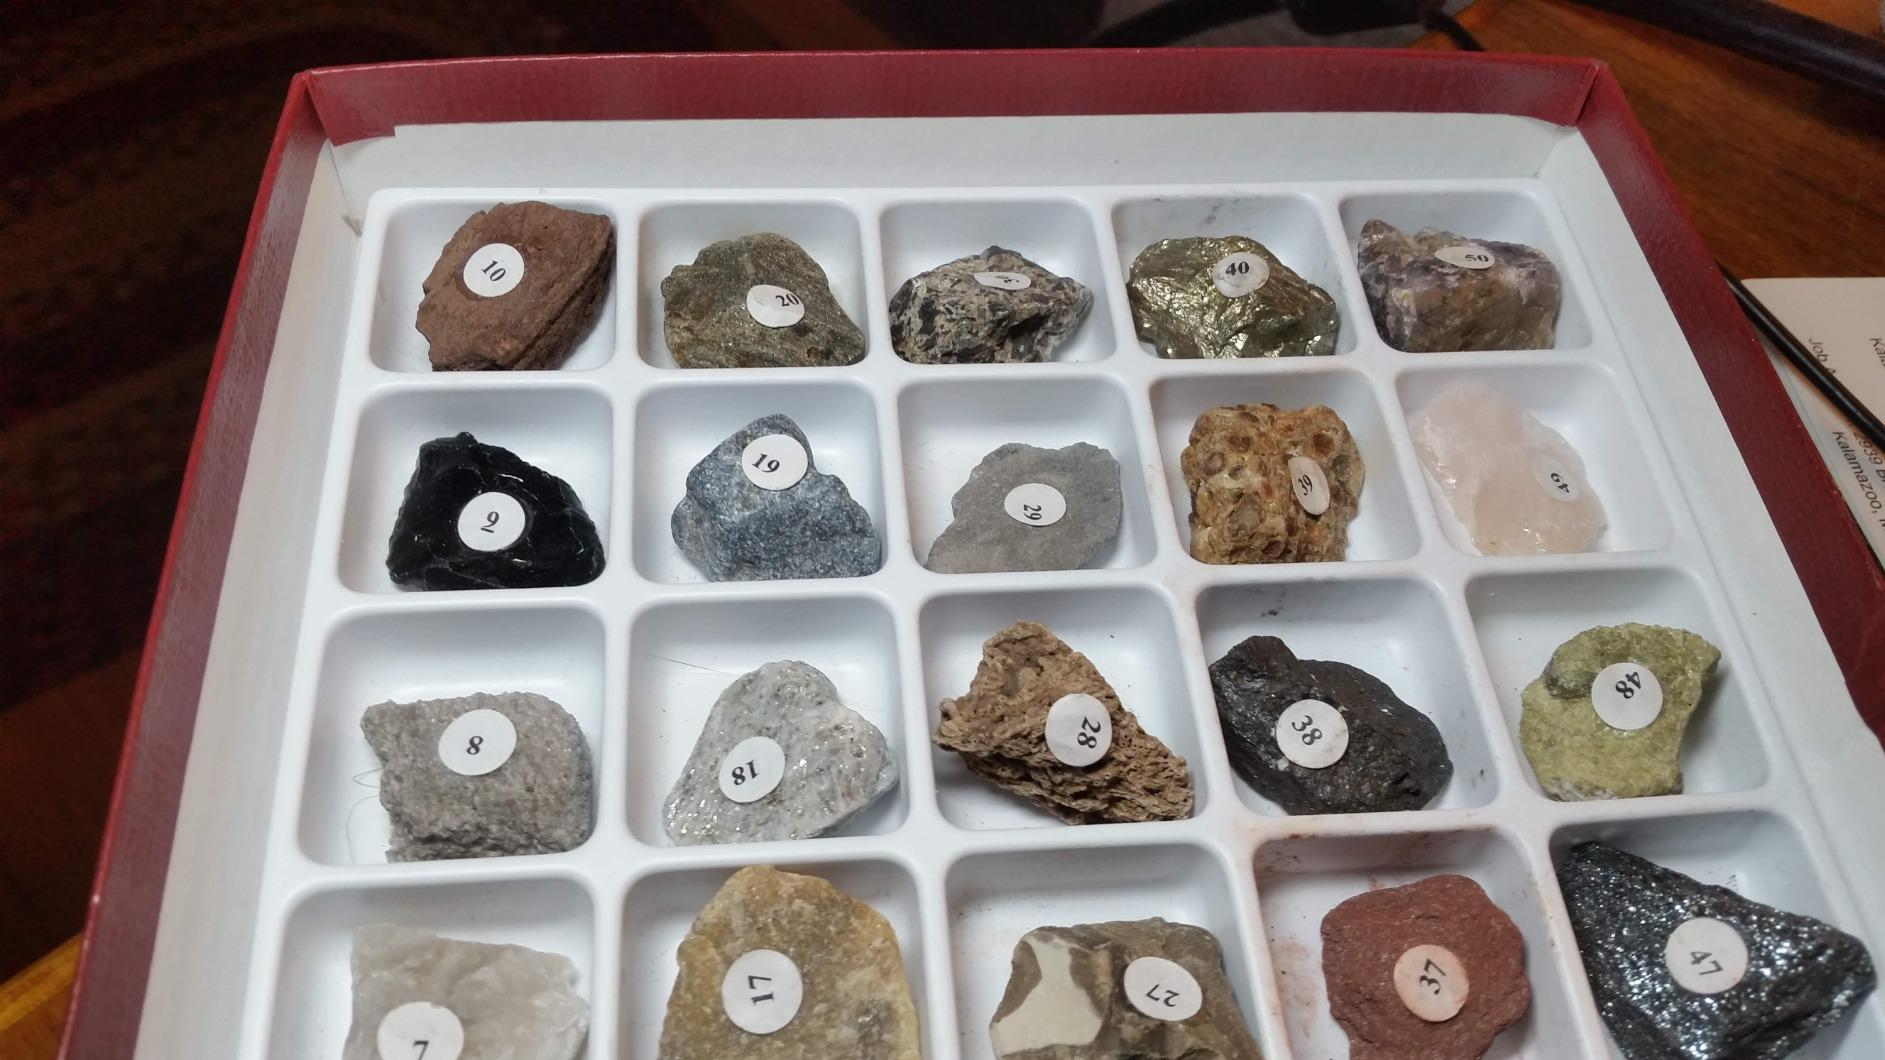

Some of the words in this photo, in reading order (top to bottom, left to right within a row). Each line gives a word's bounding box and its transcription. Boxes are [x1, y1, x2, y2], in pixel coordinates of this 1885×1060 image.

[1226, 261, 1249, 276] 40
[1465, 254, 1488, 262] 50
[481, 261, 506, 282] 10
[776, 293, 800, 307] 20
[1808, 338, 1829, 362] Job
[751, 453, 780, 473] 19
[1832, 432, 1882, 513] Kalamazoo,
[1298, 474, 1313, 495] 39
[1551, 472, 1569, 493] 49
[481, 512, 500, 533] 9
[1024, 504, 1041, 520] 29
[1615, 671, 1642, 698] 48
[1077, 717, 1100, 749] 28
[1292, 715, 1322, 746] 38
[467, 736, 483, 755] 8
[732, 760, 759, 785] 18
[1690, 950, 1723, 976] 47
[1420, 958, 1446, 994] 37
[748, 975, 772, 1005] 17
[1146, 984, 1179, 1007] 27
[413, 1040, 429, 1060] 7
